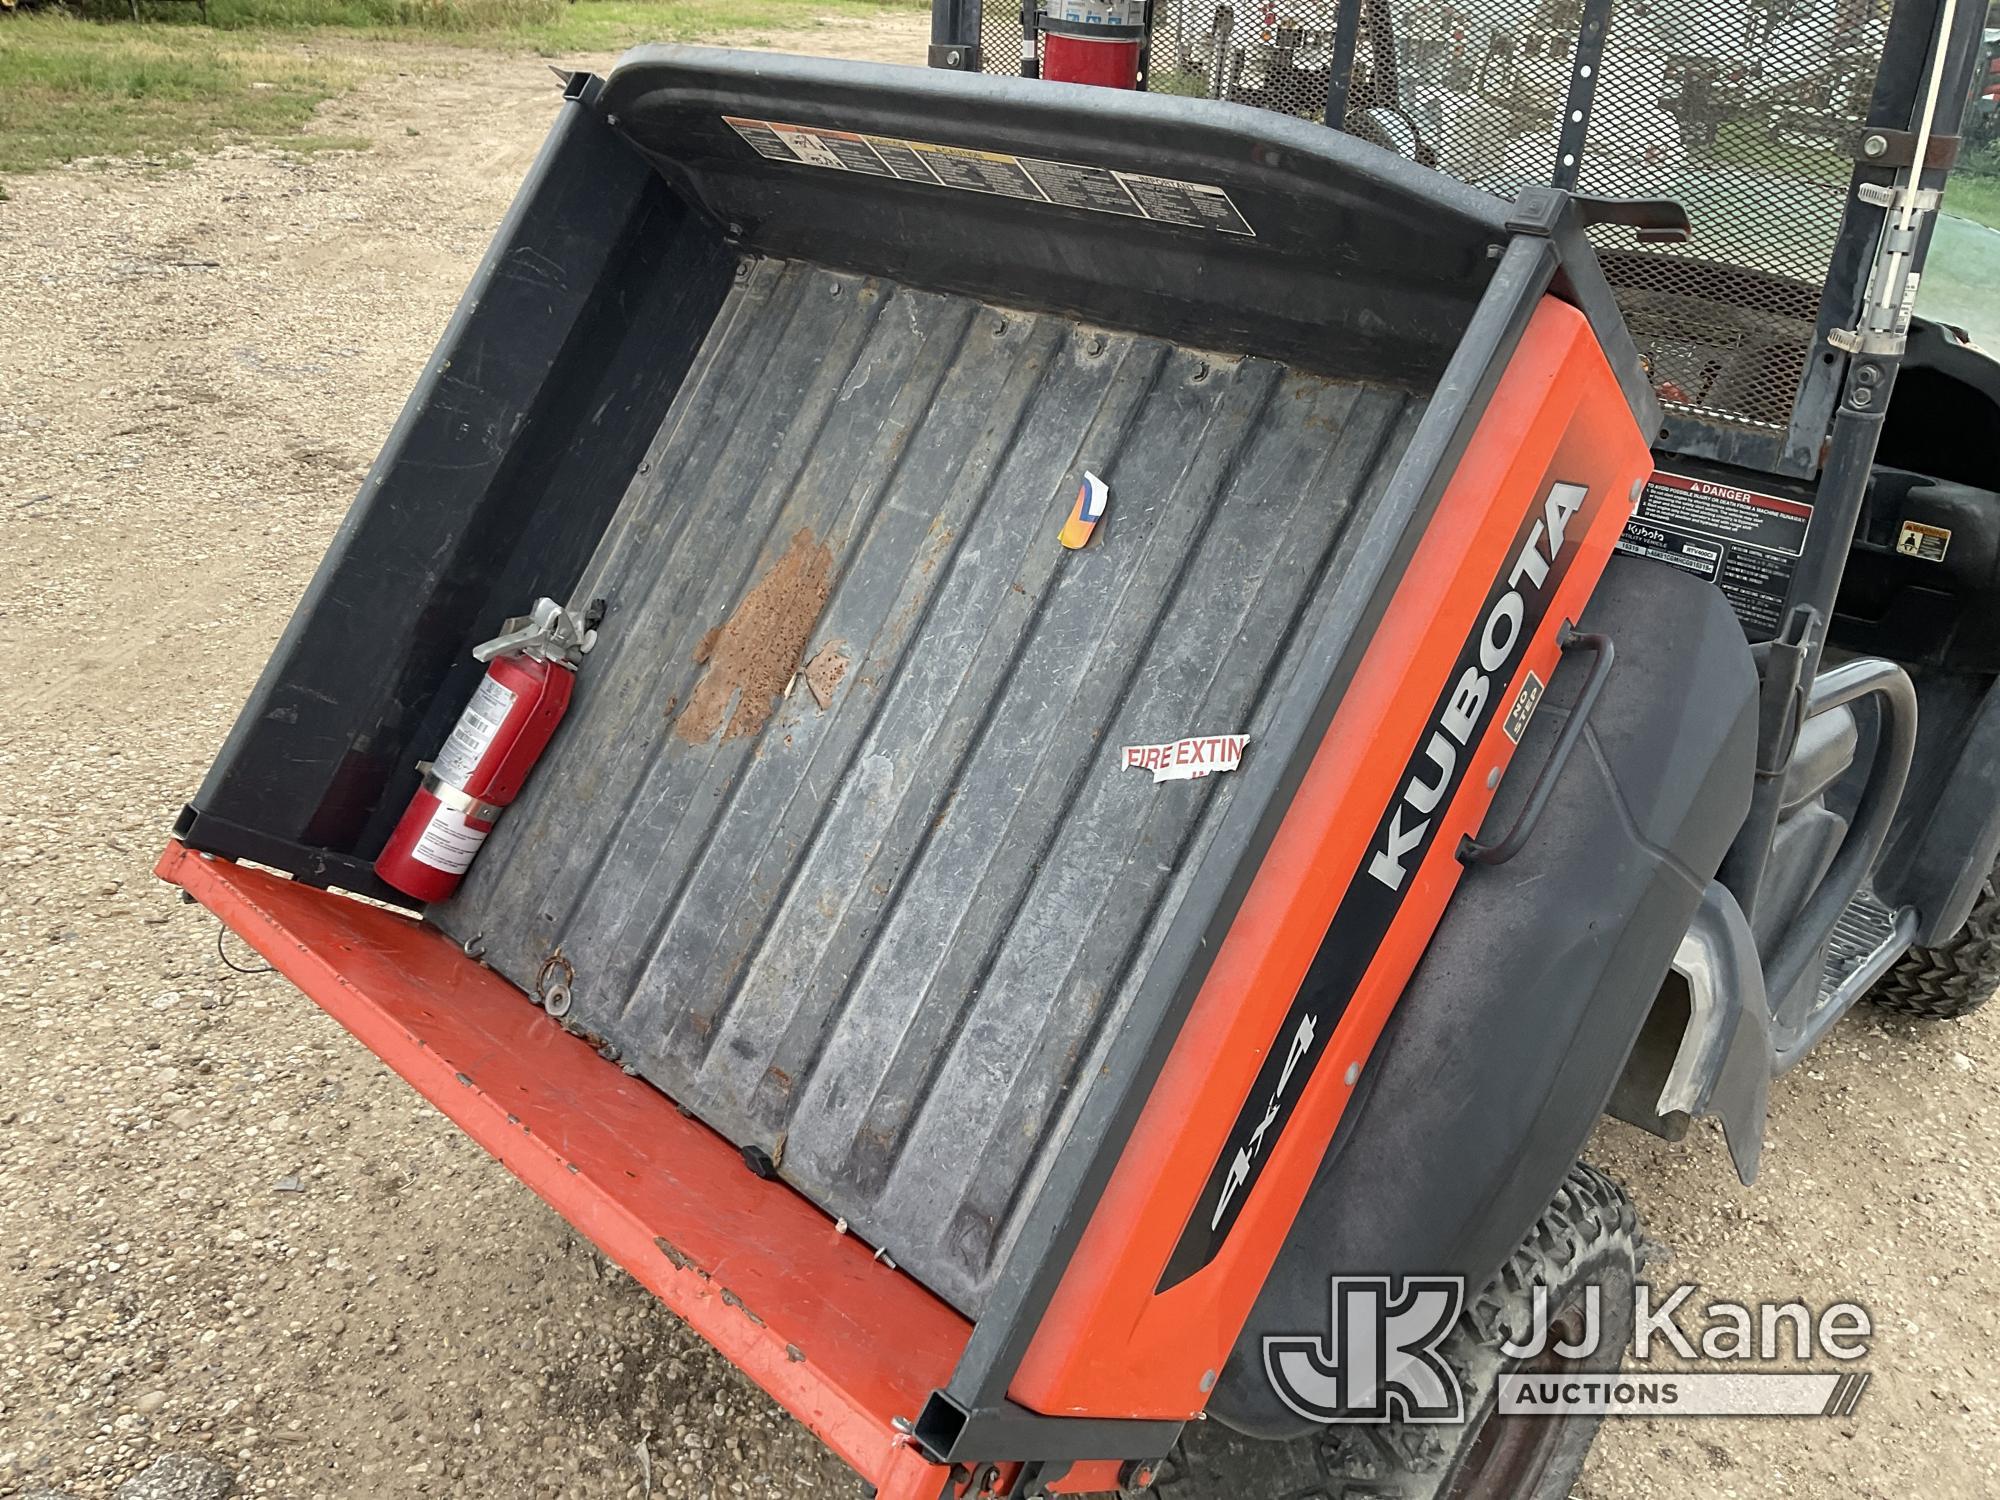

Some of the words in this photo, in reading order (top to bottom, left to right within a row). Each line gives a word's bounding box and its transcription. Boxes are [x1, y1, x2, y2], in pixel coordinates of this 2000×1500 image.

[1138, 176, 1196, 191] IMPORTANT
[1702, 485, 1751, 503] DANGER
[1627, 524, 1665, 541] Kubota
[1368, 482, 1588, 891] KUBOTA
[1513, 690, 1528, 718] NO
[1513, 687, 1537, 735] STEP
[1127, 745, 1174, 770] FIRE
